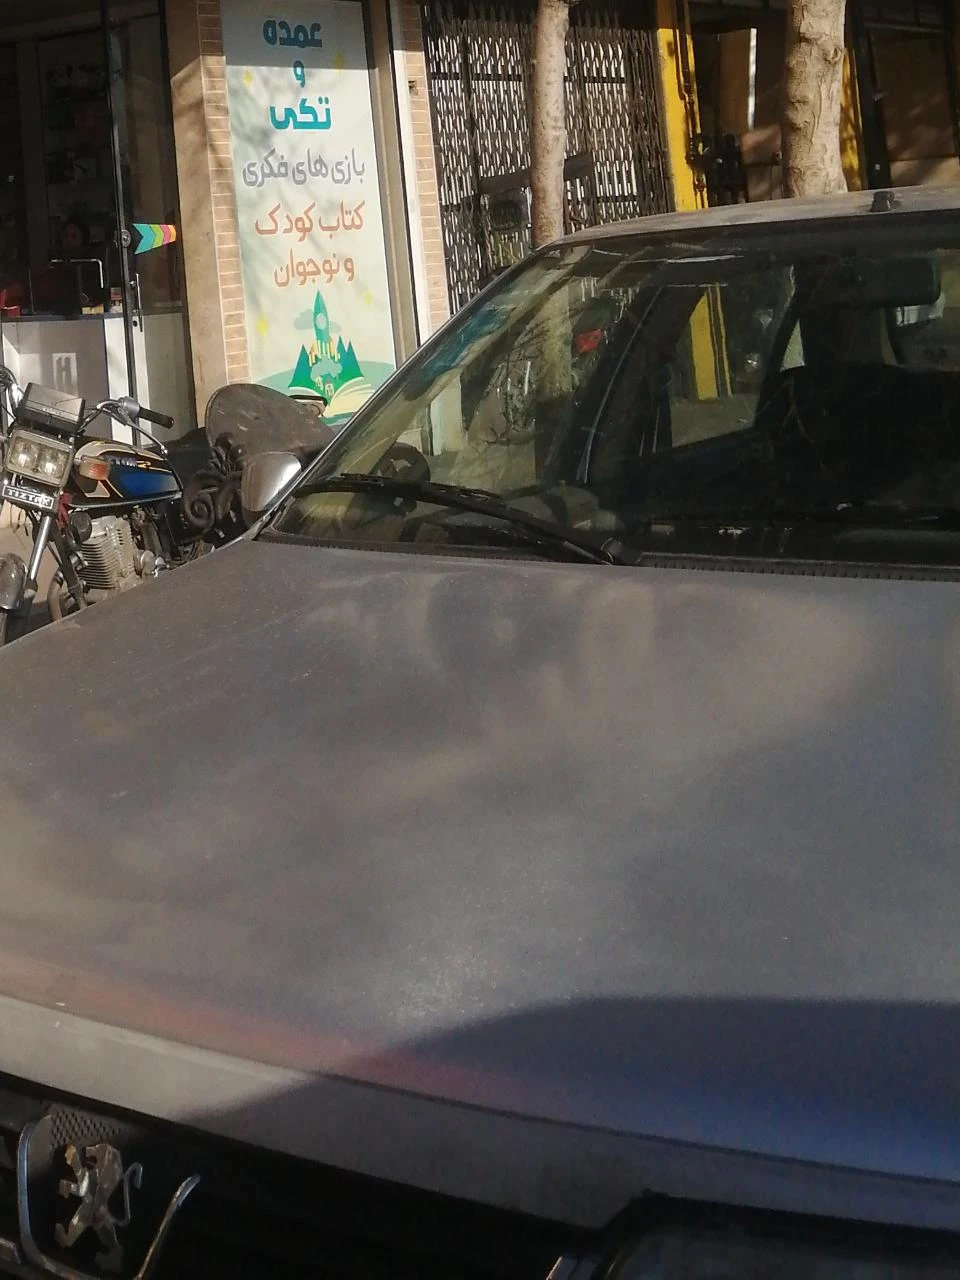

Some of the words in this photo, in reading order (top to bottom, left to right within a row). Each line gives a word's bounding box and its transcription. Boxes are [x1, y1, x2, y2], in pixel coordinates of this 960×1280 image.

[261, 18, 323, 49] عمده
[292, 60, 307, 89] و
[268, 95, 332, 131] تکی
[241, 148, 289, 188] فکری
[291, 147, 329, 186] های
[331, 147, 366, 186] بازی
[254, 200, 317, 242] کودک
[318, 199, 366, 240] کتاب
[273, 247, 341, 288] نوجوان
[343, 254, 356, 282] و
